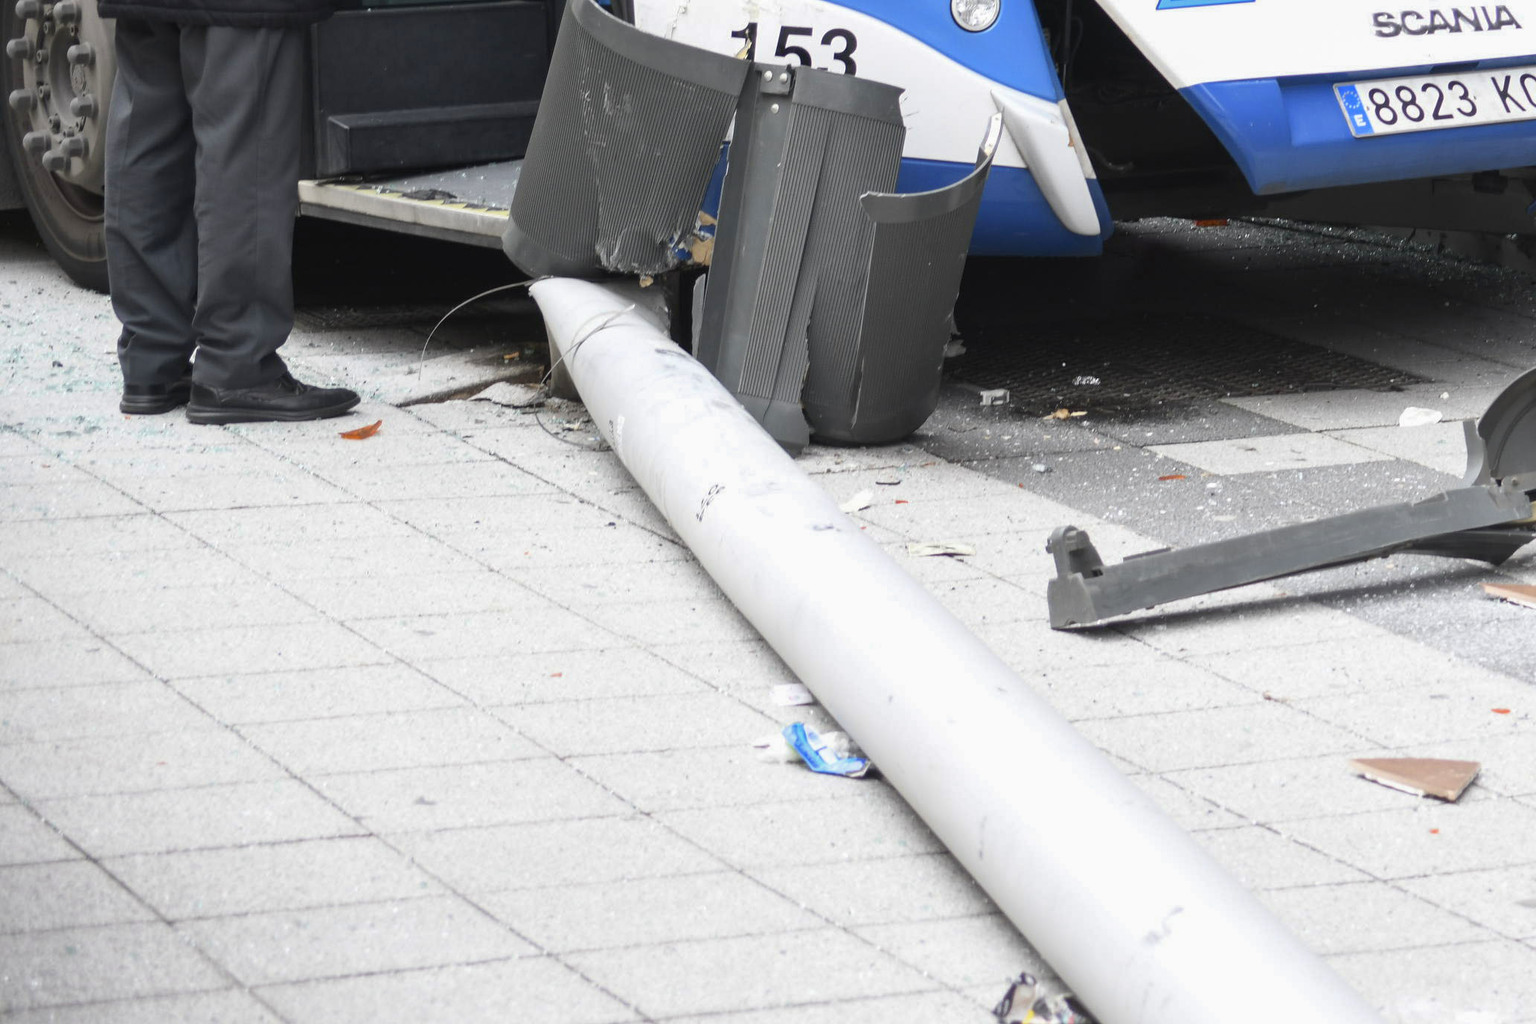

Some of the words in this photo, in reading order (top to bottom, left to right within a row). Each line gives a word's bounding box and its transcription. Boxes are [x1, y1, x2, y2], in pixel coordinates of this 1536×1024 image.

[1372, 4, 1523, 38] SCANIA
[731, 22, 858, 77] 153
[1353, 114, 1367, 128] E
[1367, 80, 1478, 126] 8823
